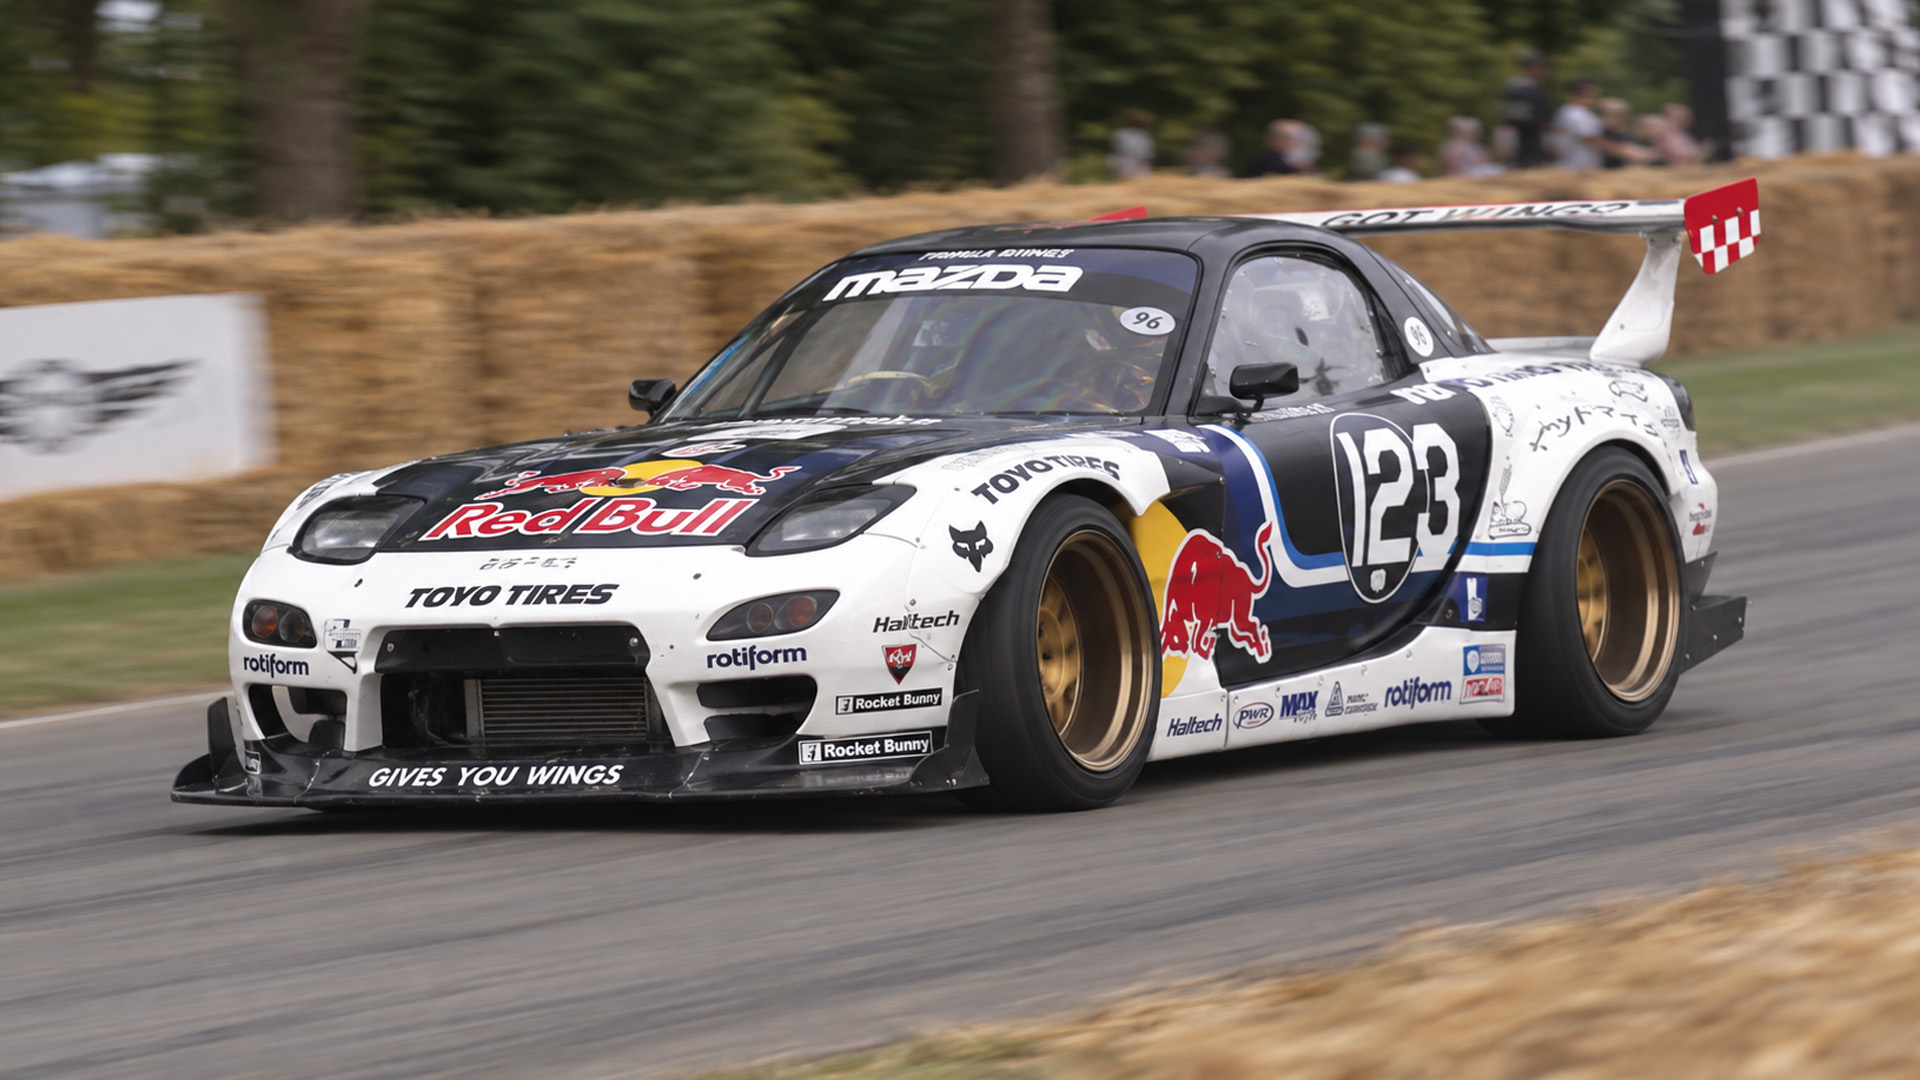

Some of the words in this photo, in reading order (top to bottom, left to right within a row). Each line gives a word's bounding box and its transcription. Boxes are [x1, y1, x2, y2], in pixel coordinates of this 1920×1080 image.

[1321, 210, 1433, 226] GOT
[1132, 312, 1163, 329] 96
[1409, 325, 1427, 345] 96
[971, 459, 1052, 504] TOYO
[1045, 455, 1120, 481] TIRES
[1336, 423, 1460, 570] 123
[418, 498, 603, 541] Red
[573, 498, 760, 537] Bull
[405, 586, 502, 608] TOYO
[505, 584, 620, 605] TIRES
[873, 610, 960, 633] Haltech
[243, 653, 309, 678] rotiform
[707, 645, 807, 671] rotiform
[855, 696, 900, 710] Rocket
[903, 692, 940, 706] Bunny
[1279, 690, 1319, 719] MAX
[1384, 676, 1452, 710] rotiform
[1166, 713, 1222, 737] Haltech
[1236, 708, 1269, 729] PWR
[824, 740, 880, 758] Rocket
[884, 738, 929, 754] Bunny
[368, 767, 447, 787] GIVES
[457, 766, 520, 786] YOU
[526, 764, 624, 785] WINGS
